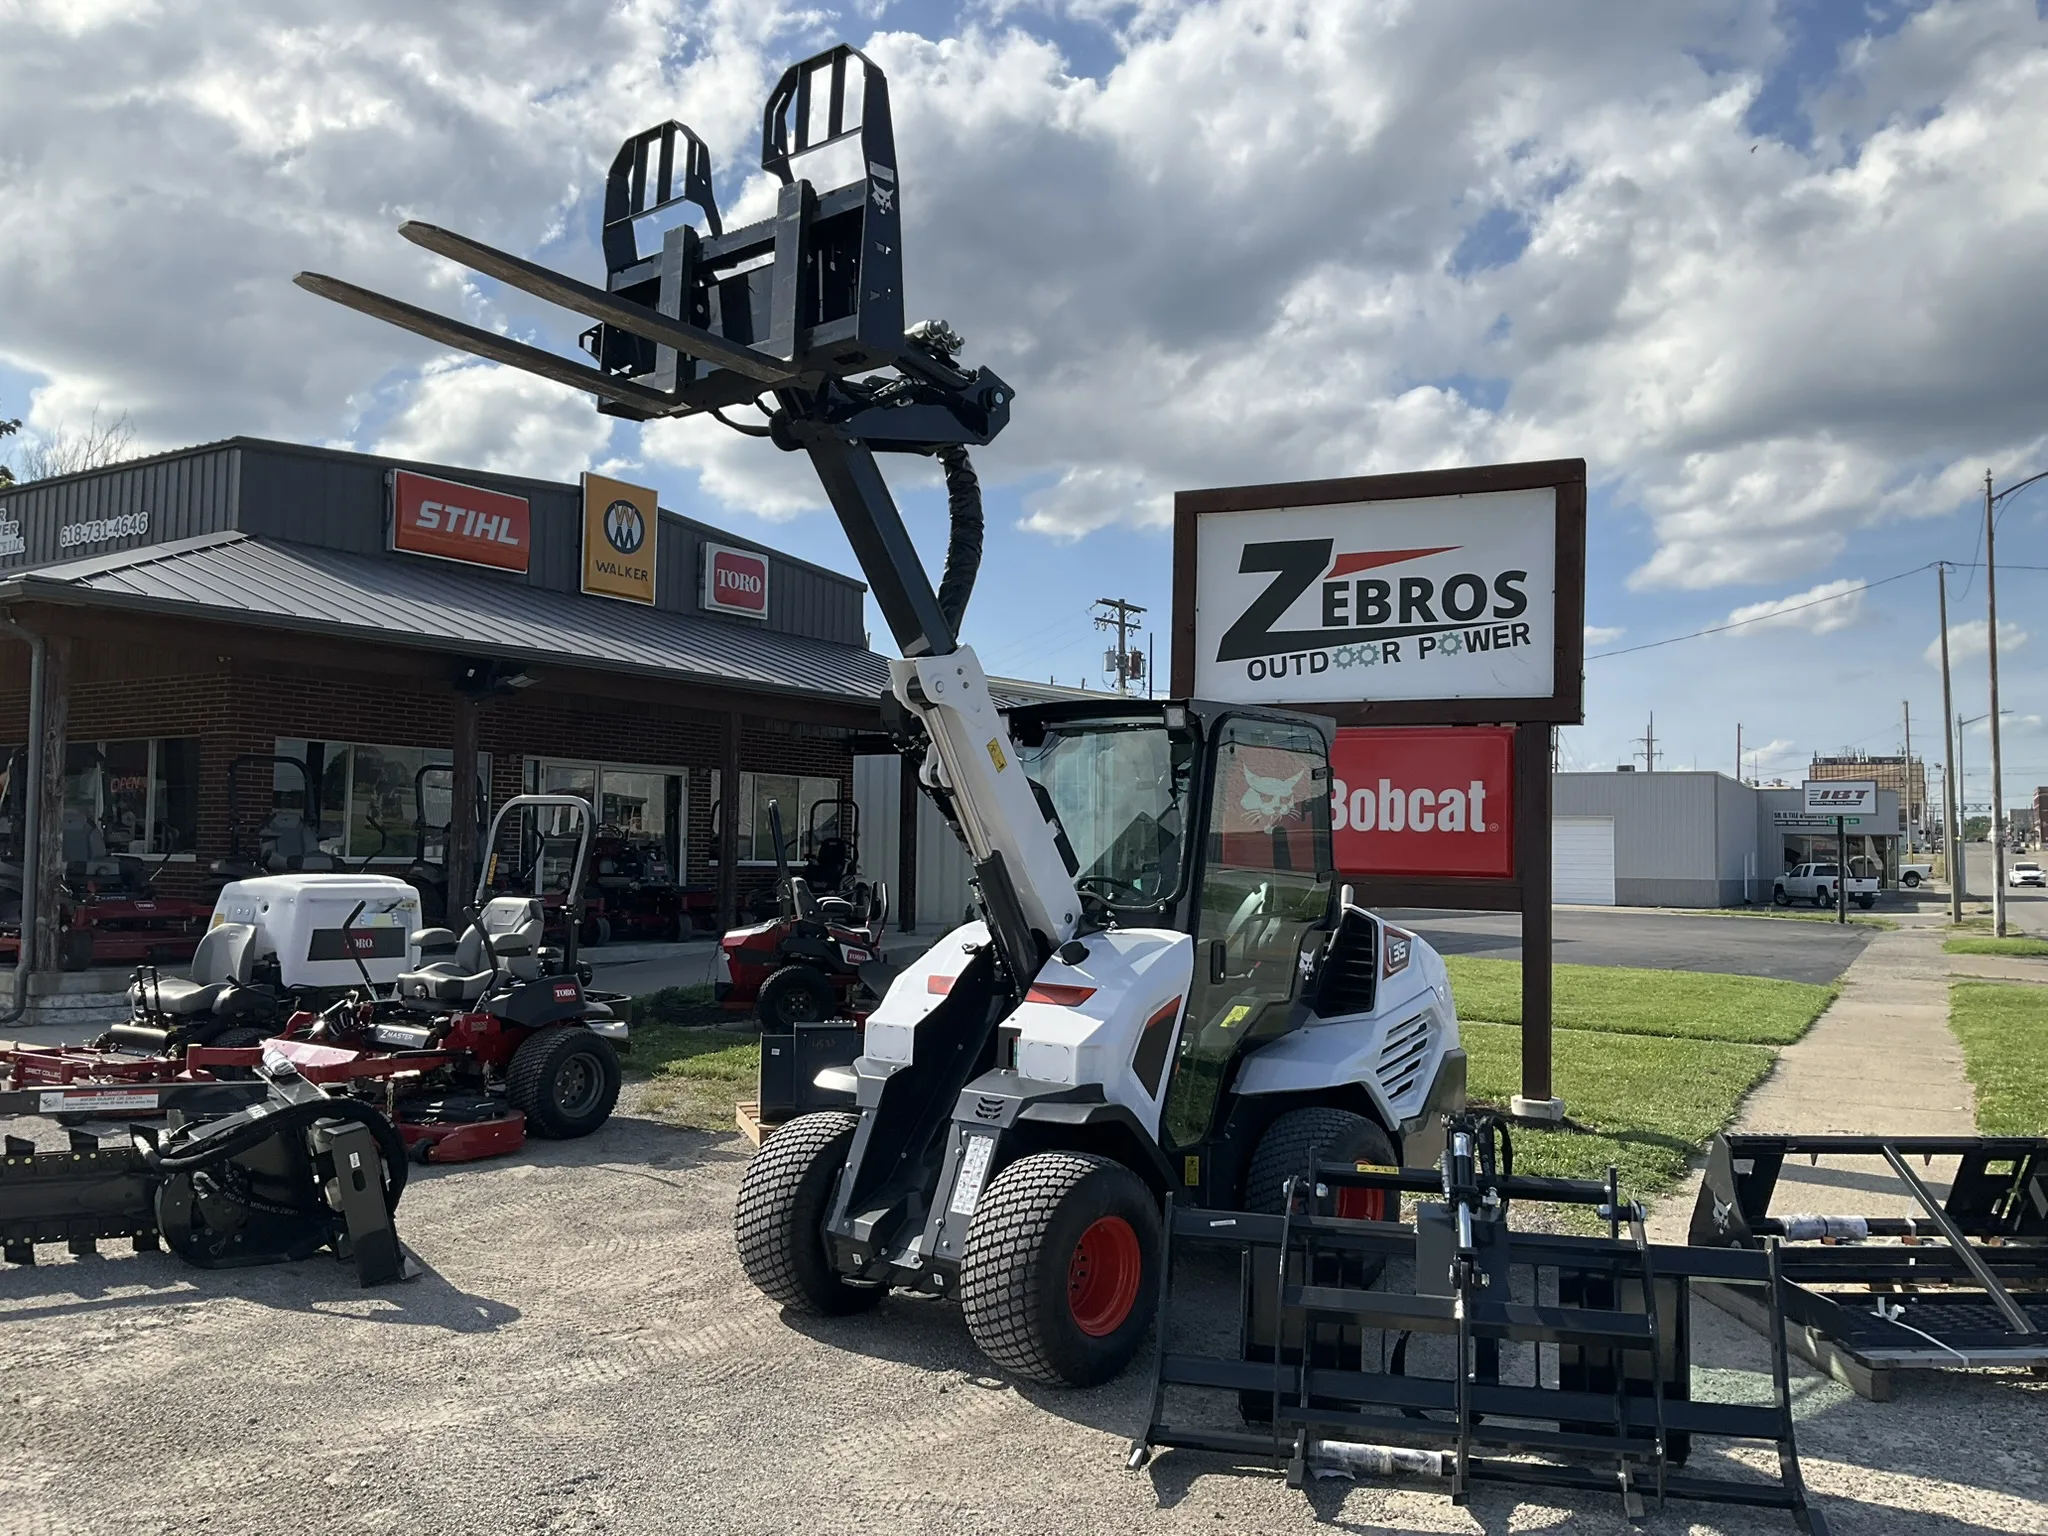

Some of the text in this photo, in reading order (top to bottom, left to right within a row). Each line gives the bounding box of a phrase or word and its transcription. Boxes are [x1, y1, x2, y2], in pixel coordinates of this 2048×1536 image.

[61, 513, 148, 547] 618-731-4646
[415, 500, 520, 546] STIHL
[595, 559, 649, 583] WALKER
[716, 568, 762, 594] TORO
[1215, 537, 1528, 662] ZEBROS
[110, 776, 140, 793] OPEN
[1820, 790, 1870, 799] IBT
[1331, 778, 1486, 833] Bobcat
[387, 1032, 415, 1041] MASTER
[42, 1069, 61, 1079] COLLEC
